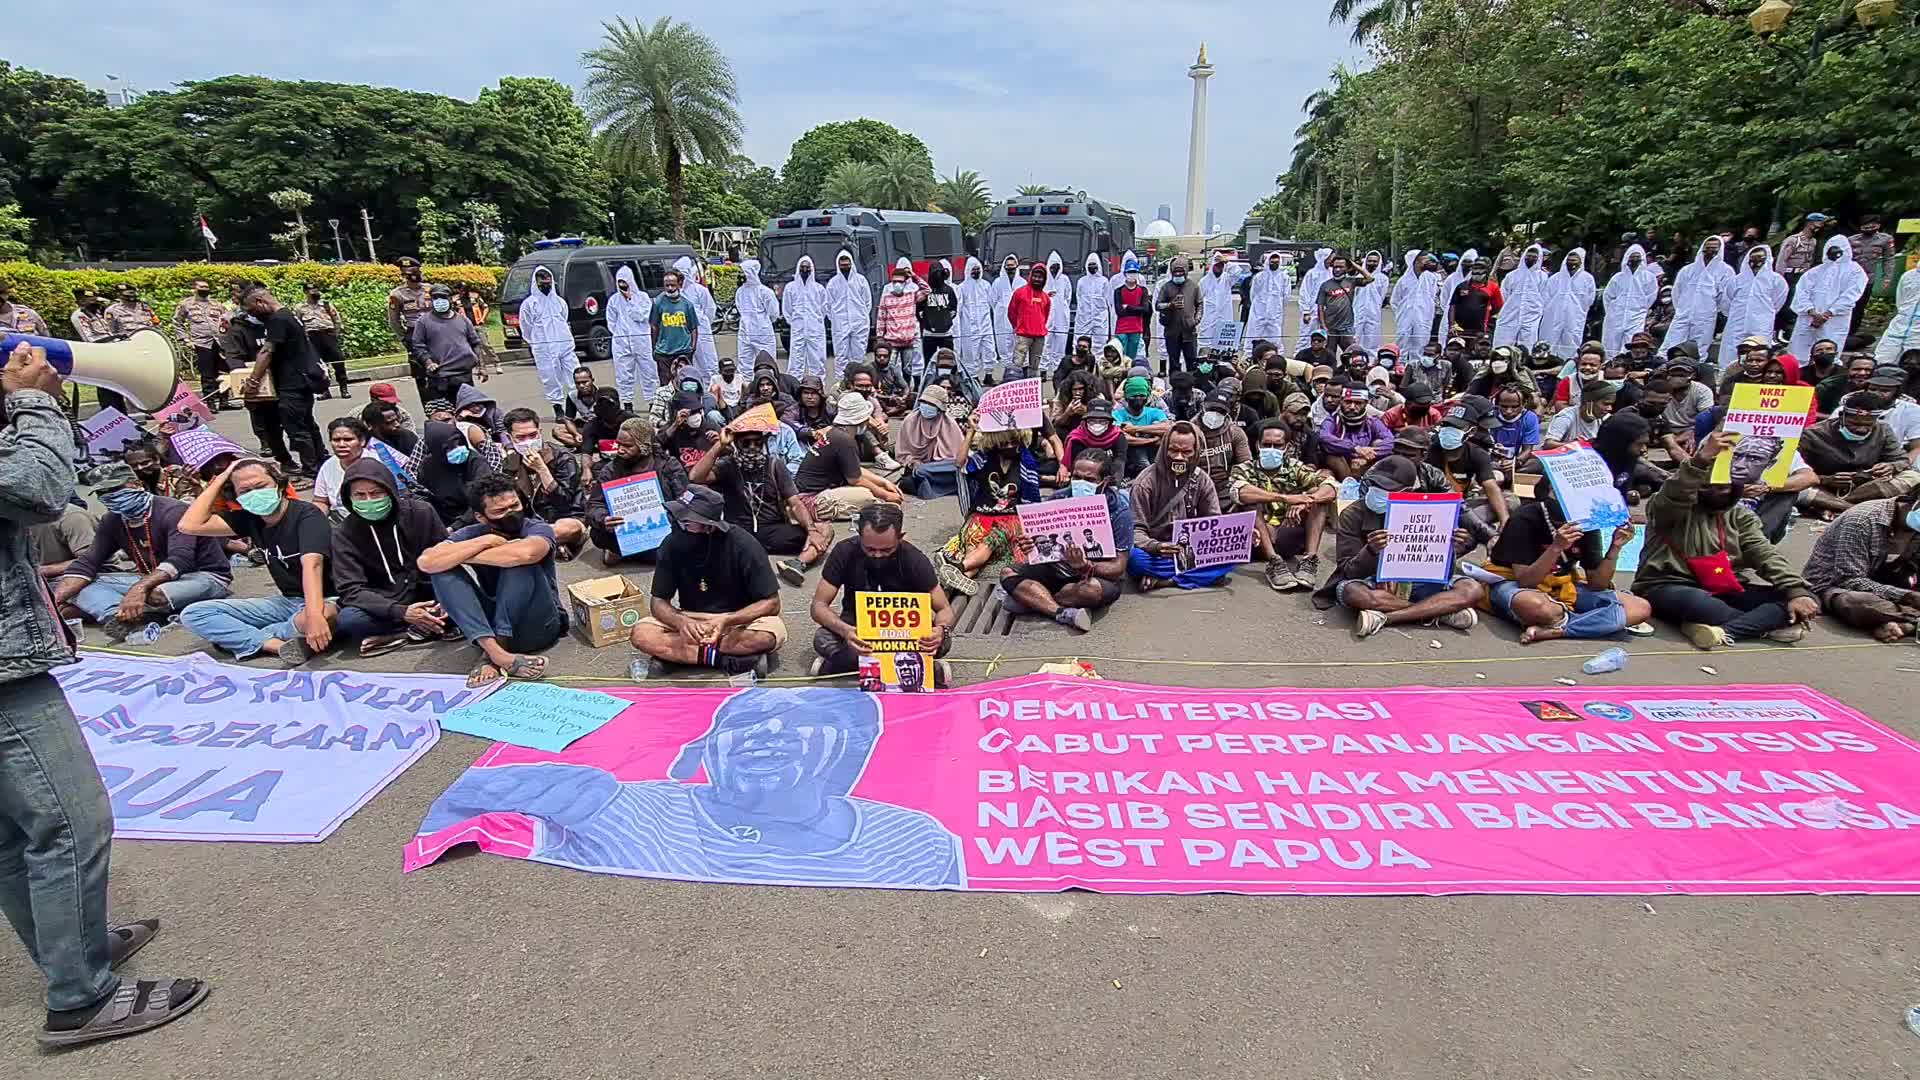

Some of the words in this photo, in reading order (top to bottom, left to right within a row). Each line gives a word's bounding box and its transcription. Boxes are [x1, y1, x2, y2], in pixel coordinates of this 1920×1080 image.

[1002, 387, 1039, 398] SENDIRI
[1760, 388, 1787, 396] NKRI
[1010, 395, 1039, 404] SOLUSI
[1760, 398, 1779, 408] NO
[1727, 412, 1804, 426] REFERENDUM
[1753, 426, 1775, 436] YES
[1038, 510, 1058, 518] PAPUA
[1410, 514, 1432, 524] USUT
[1024, 518, 1052, 527] CHILDREN
[1037, 521, 1084, 532] INDONESIA'S
[1182, 519, 1219, 534] STOP
[1210, 526, 1245, 538] SLOW
[1402, 524, 1436, 534] PELAKU
[1198, 534, 1248, 548] MOTION
[1388, 534, 1448, 544] PENEMBAKAN
[1196, 543, 1246, 556] GENOCIDE
[1405, 544, 1429, 552] ANAK
[1386, 554, 1396, 562] DI
[1398, 554, 1422, 562] INTAN
[1424, 554, 1444, 562] JAYA
[866, 597, 920, 608] PEPERA
[866, 610, 920, 628] 1969
[878, 629, 911, 638] TIDAK
[979, 698, 1392, 721] DEMILITERISASI
[978, 727, 1164, 754] CABUT
[1177, 731, 1665, 755] PERPANJANGAN
[1666, 730, 1878, 754] OTSUS
[978, 764, 1244, 796] BERIKAN
[1254, 771, 1395, 795] HAK
[1397, 770, 1864, 795] MENENTUKAN
[978, 795, 1170, 829] NASIB
[1184, 802, 1453, 831] SENDIRI
[1456, 802, 1625, 830] BAGI
[1632, 802, 1920, 830] BANGSA
[974, 831, 1165, 867] WEST
[1181, 838, 1433, 870] PAPUA
